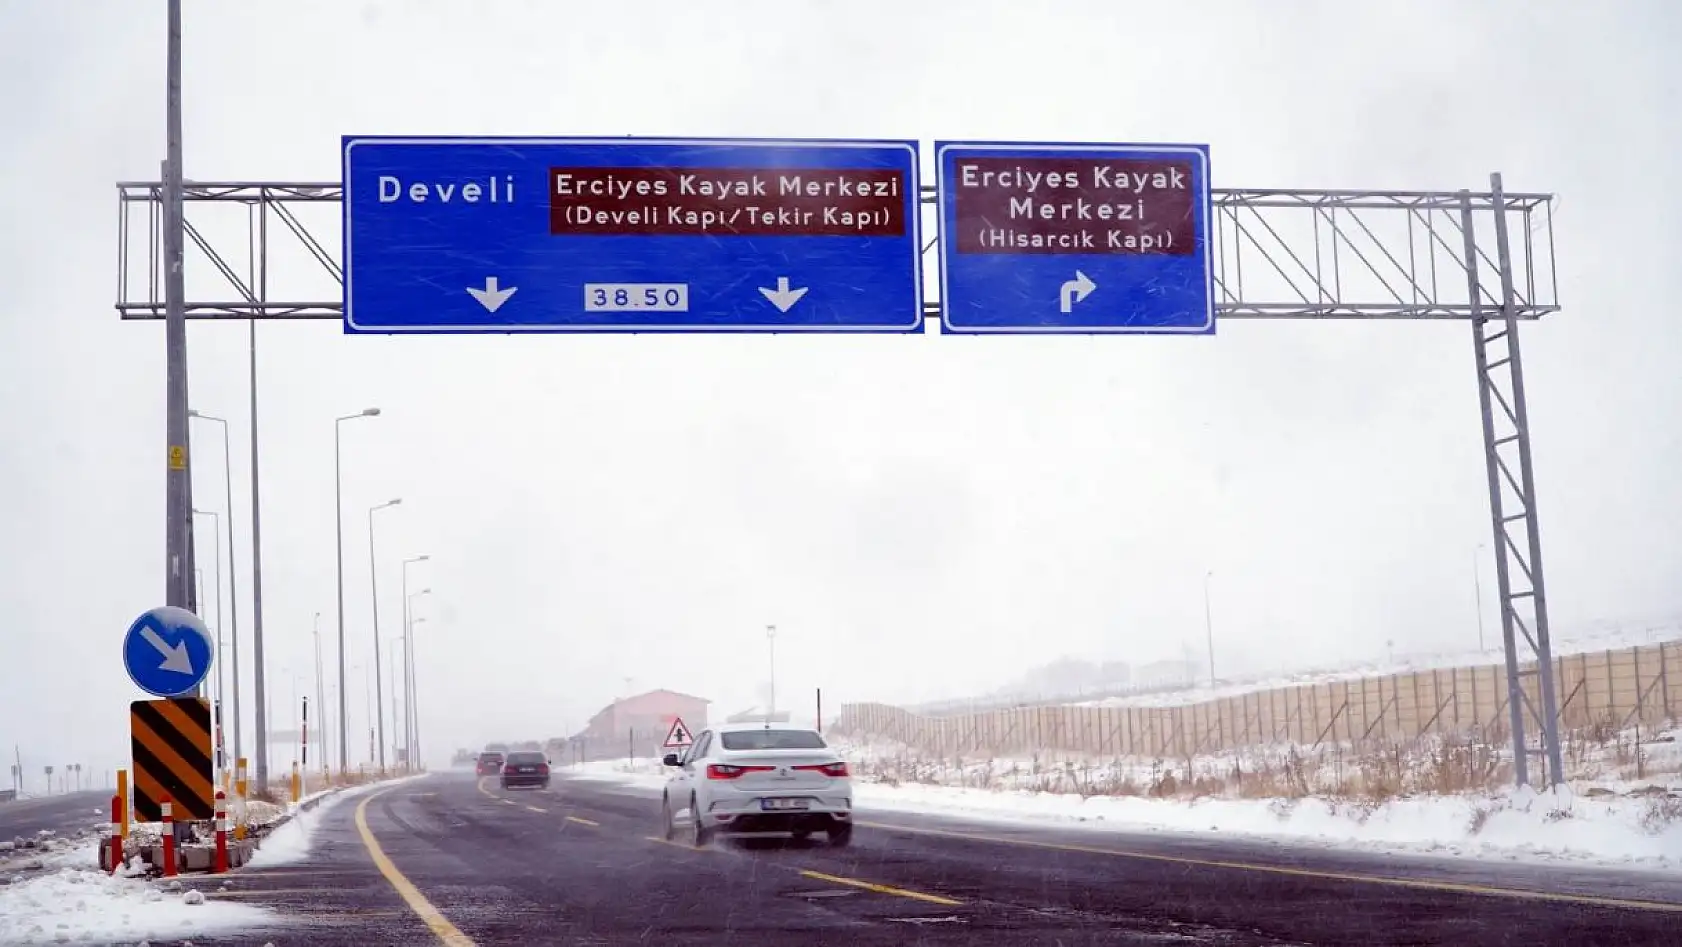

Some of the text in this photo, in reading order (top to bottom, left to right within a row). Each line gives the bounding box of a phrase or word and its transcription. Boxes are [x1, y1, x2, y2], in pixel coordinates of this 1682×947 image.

[379, 175, 514, 203] Develi
[557, 173, 897, 200] Erciyes Kayak Merkezi
[961, 165, 1185, 194] Erciyes Kayak
[565, 205, 890, 230] (Develi Kapı/Tekir Kapı)
[1010, 196, 1145, 220] Merkezi
[979, 228, 1172, 254] (Hisarcık Kapı)
[592, 288, 681, 308] 38.50
